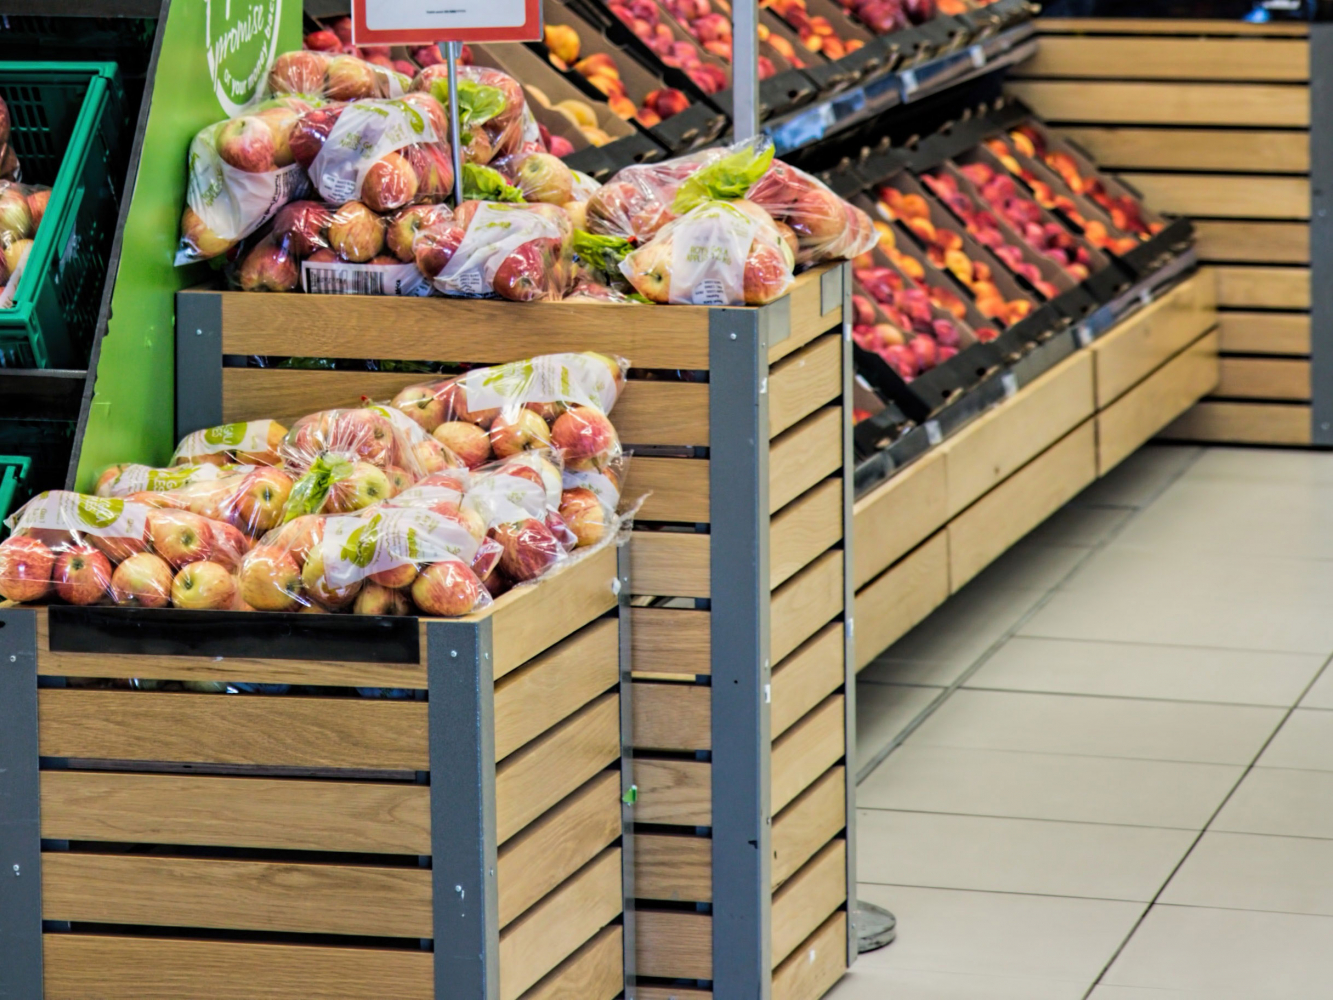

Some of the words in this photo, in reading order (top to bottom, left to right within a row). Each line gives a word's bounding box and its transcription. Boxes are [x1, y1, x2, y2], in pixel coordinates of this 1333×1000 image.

[213, 3, 265, 65] promise
[224, 68, 231, 86] or
[231, 81, 247, 98] your
[247, 47, 268, 91] money
